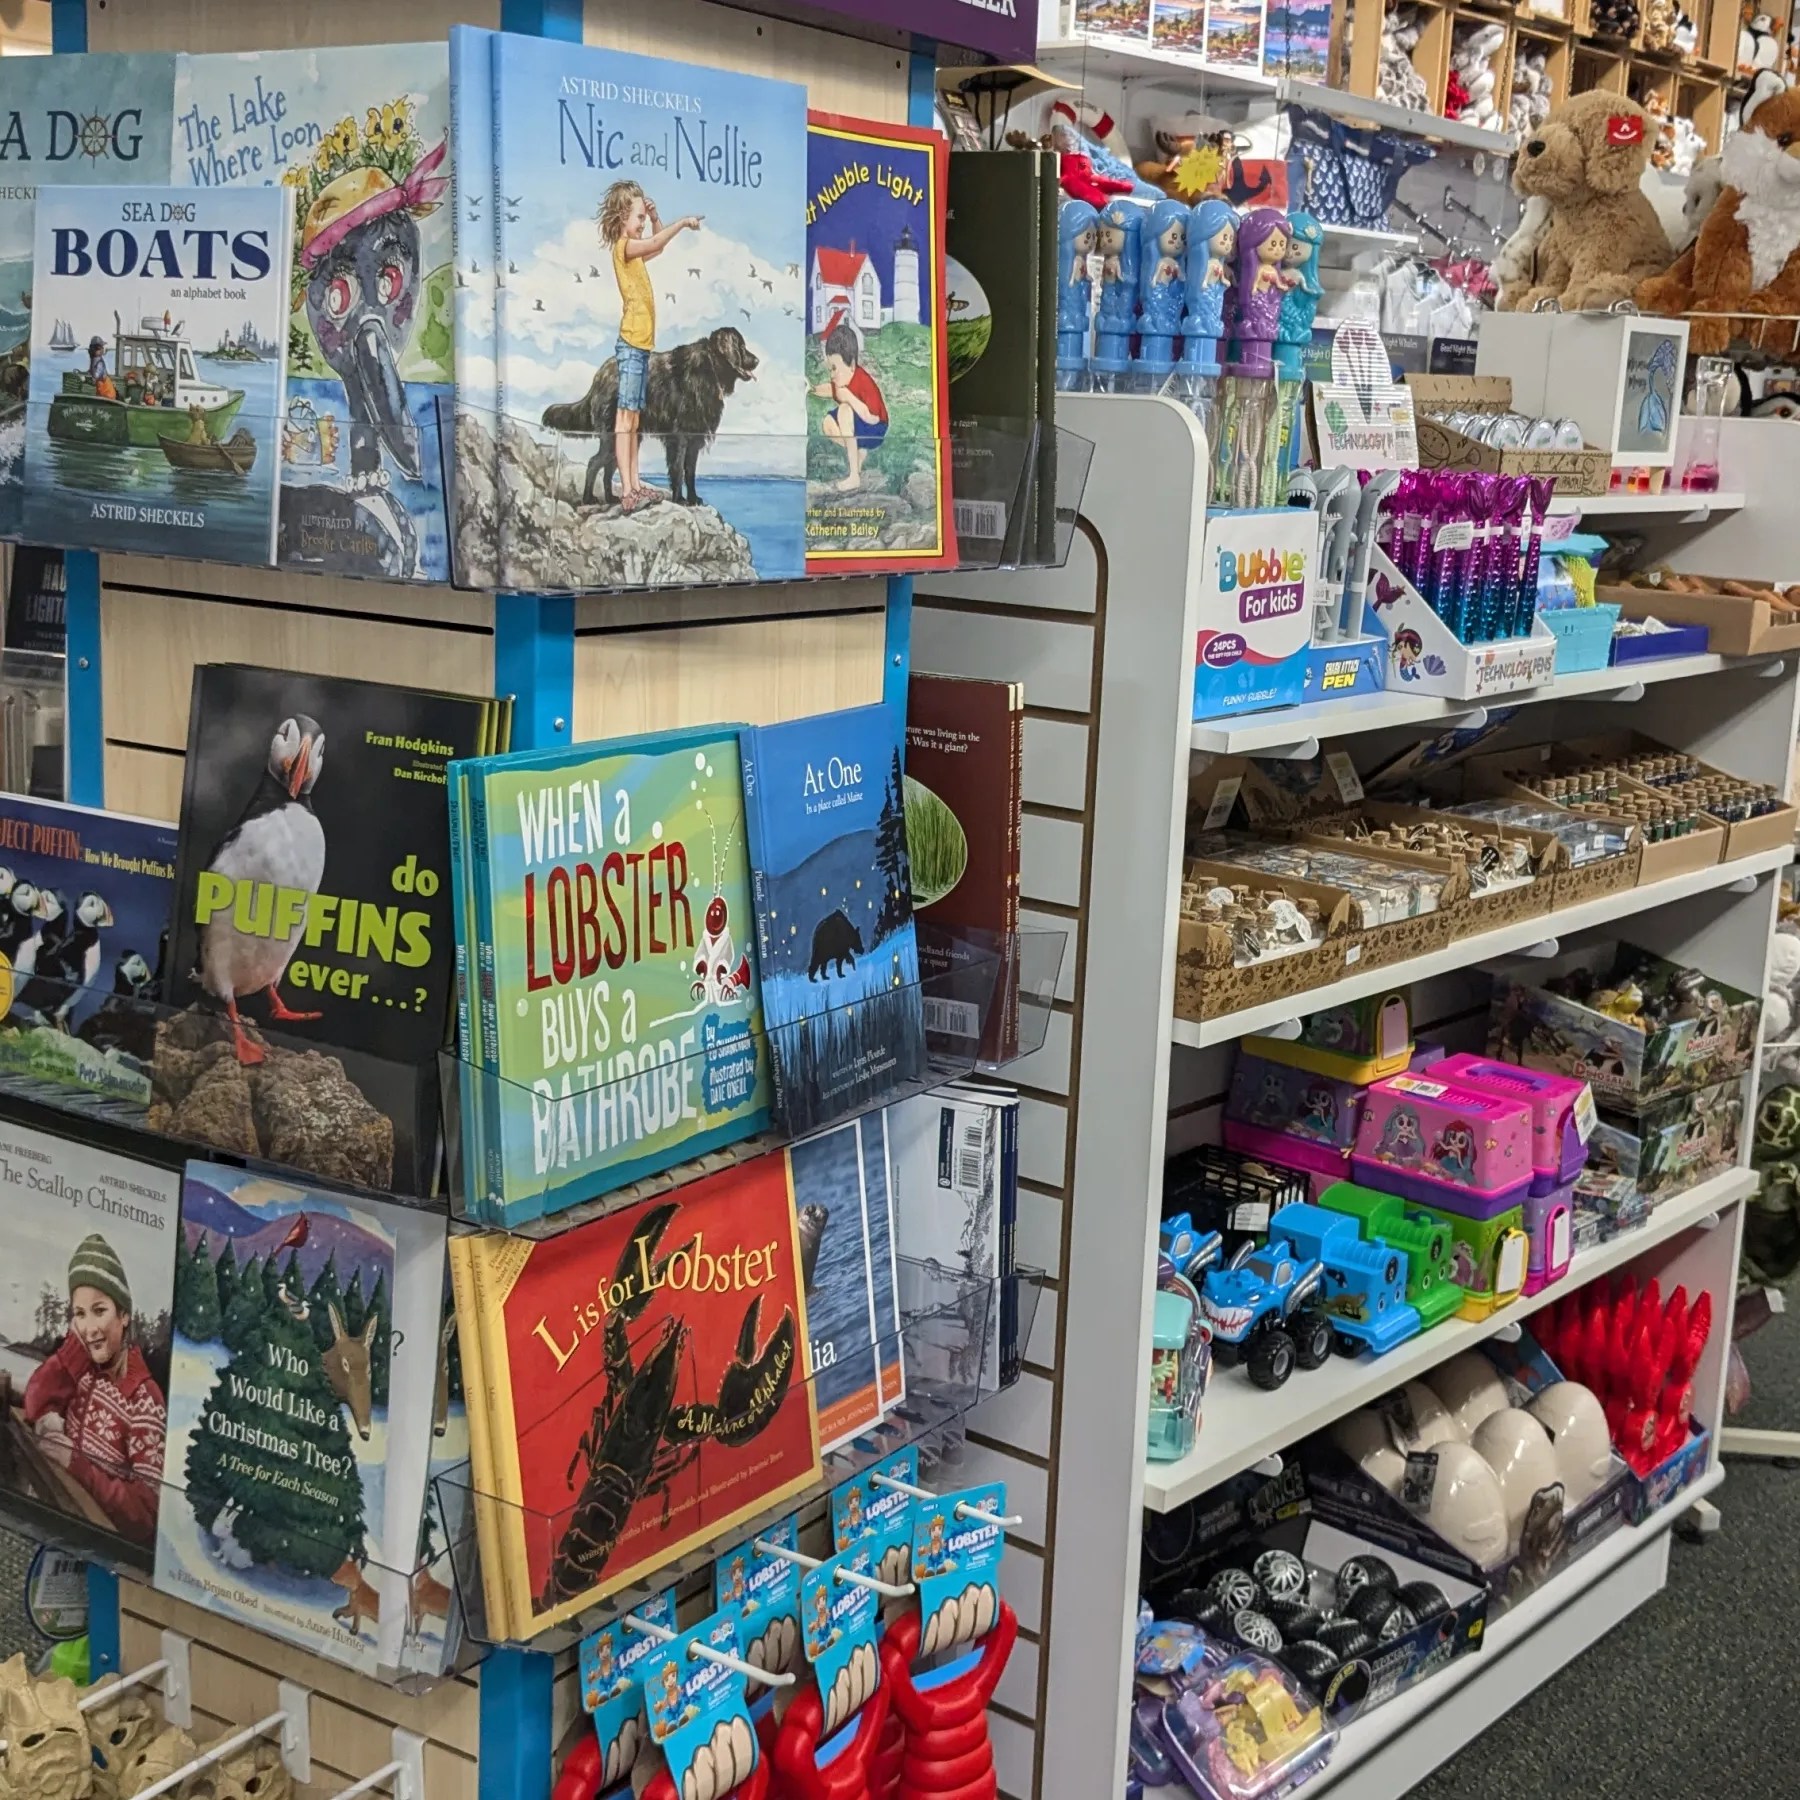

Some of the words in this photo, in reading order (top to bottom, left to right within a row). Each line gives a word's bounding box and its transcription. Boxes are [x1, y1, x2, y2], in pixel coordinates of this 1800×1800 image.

[559, 76, 618, 101] ASTRID
[622, 86, 702, 114] SHECKELS
[178, 104, 222, 153] The
[230, 75, 288, 135] Lake
[188, 143, 262, 188] Where
[271, 118, 325, 165] Loon
[557, 99, 624, 169] Nic
[631, 133, 668, 171] and
[674, 116, 762, 188] Nellie
[817, 162, 870, 213] Nubble
[877, 164, 923, 208] Light
[122, 203, 156, 223] SEA
[50, 227, 271, 281] BOATS
[170, 288, 183, 298] an
[183, 286, 223, 302] alphabet
[223, 287, 247, 301] book
[90, 503, 137, 522] ASTRID
[139, 506, 205, 529] SHECKELS
[837, 507, 876, 519] Illustrated
[876, 508, 885, 520] by
[851, 523, 879, 539] Bailey
[1245, 595, 1267, 618] For
[1270, 588, 1297, 614] kids
[1213, 640, 1237, 652] 24PCS
[1322, 673, 1356, 691] PEN
[1223, 693, 1247, 706] FUNNY
[365, 731, 393, 747] Fran
[395, 735, 455, 756] Hodgkins
[912, 736, 930, 748] Was
[930, 740, 937, 749] it
[944, 742, 968, 754] giant?
[923, 728, 936, 737] was
[937, 728, 957, 741] living
[958, 731, 966, 741] in
[967, 732, 980, 742] the
[394, 767, 412, 779] Dan
[413, 770, 449, 785] Kirchof
[744, 758, 754, 773] At
[803, 763, 825, 797] At
[828, 757, 862, 789] One
[745, 774, 756, 797] One
[805, 803, 813, 815] In
[813, 804, 818, 813] a
[818, 798, 832, 813] place
[832, 794, 847, 808] called
[847, 791, 863, 803] Maine
[517, 779, 604, 866] WHEN
[615, 789, 631, 846] a
[85, 848, 100, 865] How
[101, 851, 113, 867] We
[113, 853, 141, 874] Brought
[141, 859, 167, 878] Puffins
[391, 855, 439, 898] do
[194, 871, 432, 968] PUFFINS
[524, 841, 695, 993] LOBSTER
[541, 980, 610, 1069] BUYS
[621, 988, 637, 1044] a
[706, 1024, 716, 1043] by
[79, 1063, 97, 1082] Pete
[709, 1058, 744, 1086] illustrated
[743, 1059, 755, 1076] by
[531, 1024, 698, 1176] BATHROBE
[710, 1081, 726, 1105] DAVE
[26, 1167, 84, 1208] Scallop
[87, 1186, 166, 1230] Christmas
[99, 1174, 127, 1192] ASTRID
[128, 1182, 168, 1203] SHECKELS
[532, 1314, 580, 1373] L
[573, 1297, 600, 1338] is
[596, 1270, 636, 1313] for
[633, 1231, 778, 1294] Lobster
[267, 1342, 310, 1378] Who
[229, 1374, 284, 1412] Would
[287, 1393, 326, 1426] Like
[327, 1414, 340, 1432] a
[677, 1409, 694, 1431] A
[208, 1410, 299, 1459] Christmas
[302, 1440, 352, 1480] Tree?
[217, 1453, 228, 1467] A
[229, 1458, 255, 1477] Tree
[255, 1464, 271, 1482] for
[272, 1471, 301, 1494] Each
[302, 1482, 339, 1508] Season
[948, 1522, 999, 1553] LOBSTER
[305, 1617, 332, 1637] Anne
